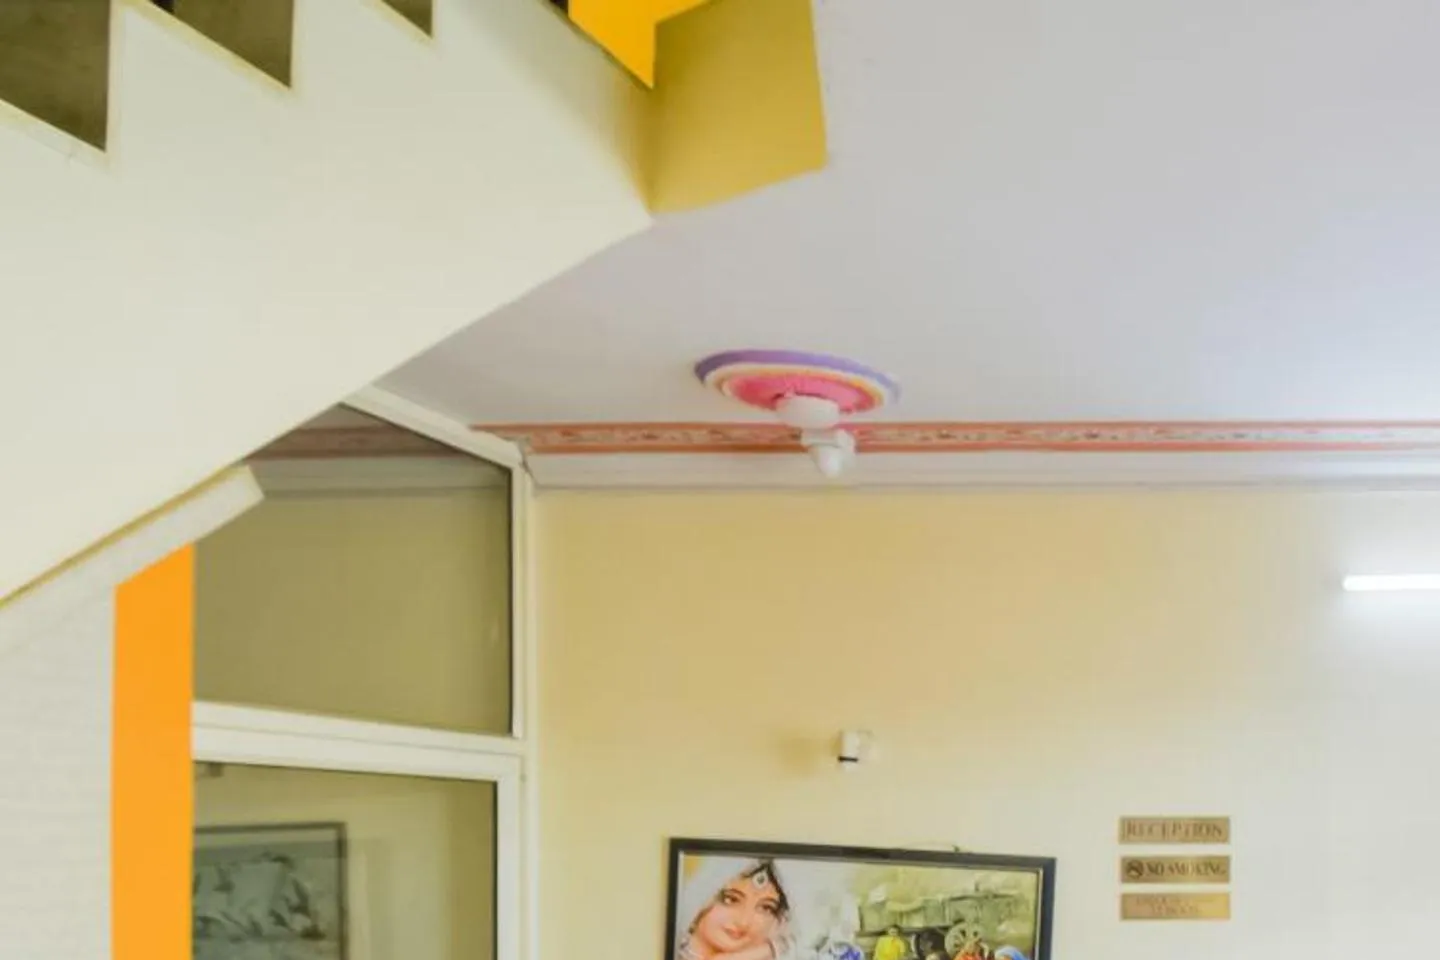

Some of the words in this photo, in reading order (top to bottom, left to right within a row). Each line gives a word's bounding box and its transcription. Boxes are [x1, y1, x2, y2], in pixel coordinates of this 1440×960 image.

[1125, 820, 1223, 838] RECEPTION
[1145, 860, 1165, 877] NO
[1167, 859, 1227, 877] SMOKING
